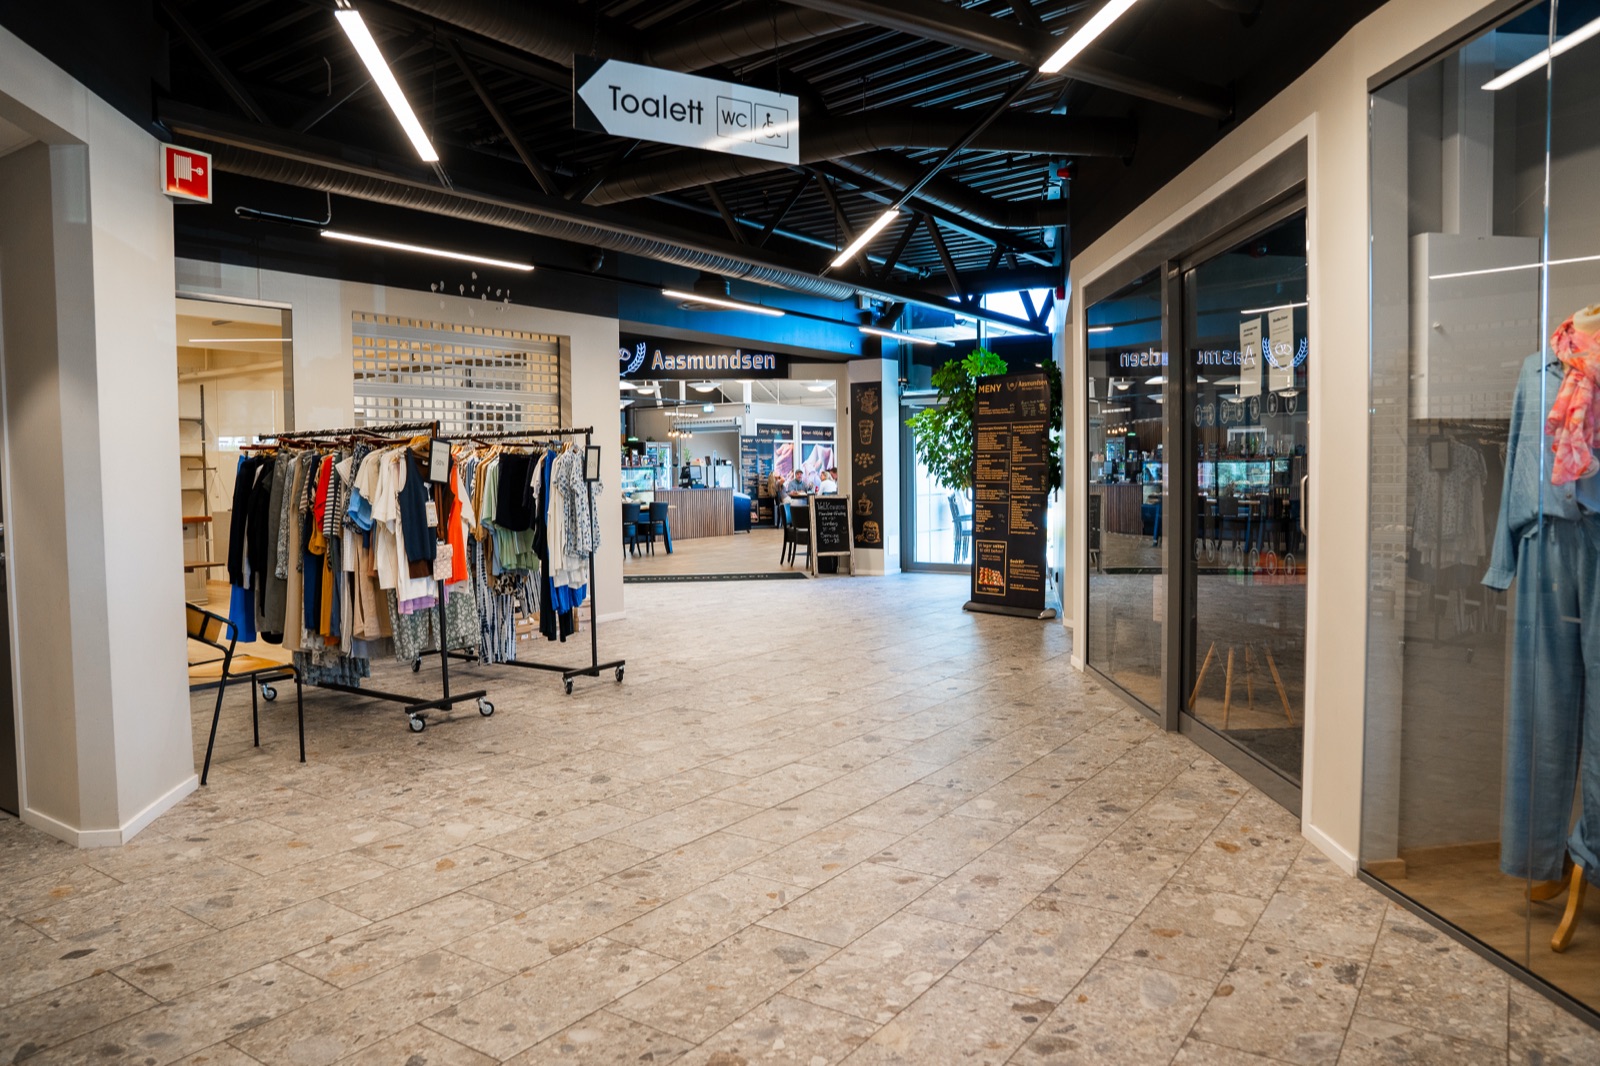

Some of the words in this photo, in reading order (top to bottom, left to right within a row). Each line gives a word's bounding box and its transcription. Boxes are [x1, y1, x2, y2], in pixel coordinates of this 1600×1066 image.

[608, 84, 704, 126] Toalett
[721, 109, 748, 129] WC
[651, 349, 776, 370] Aasmundsen
[978, 383, 1002, 394] MENY
